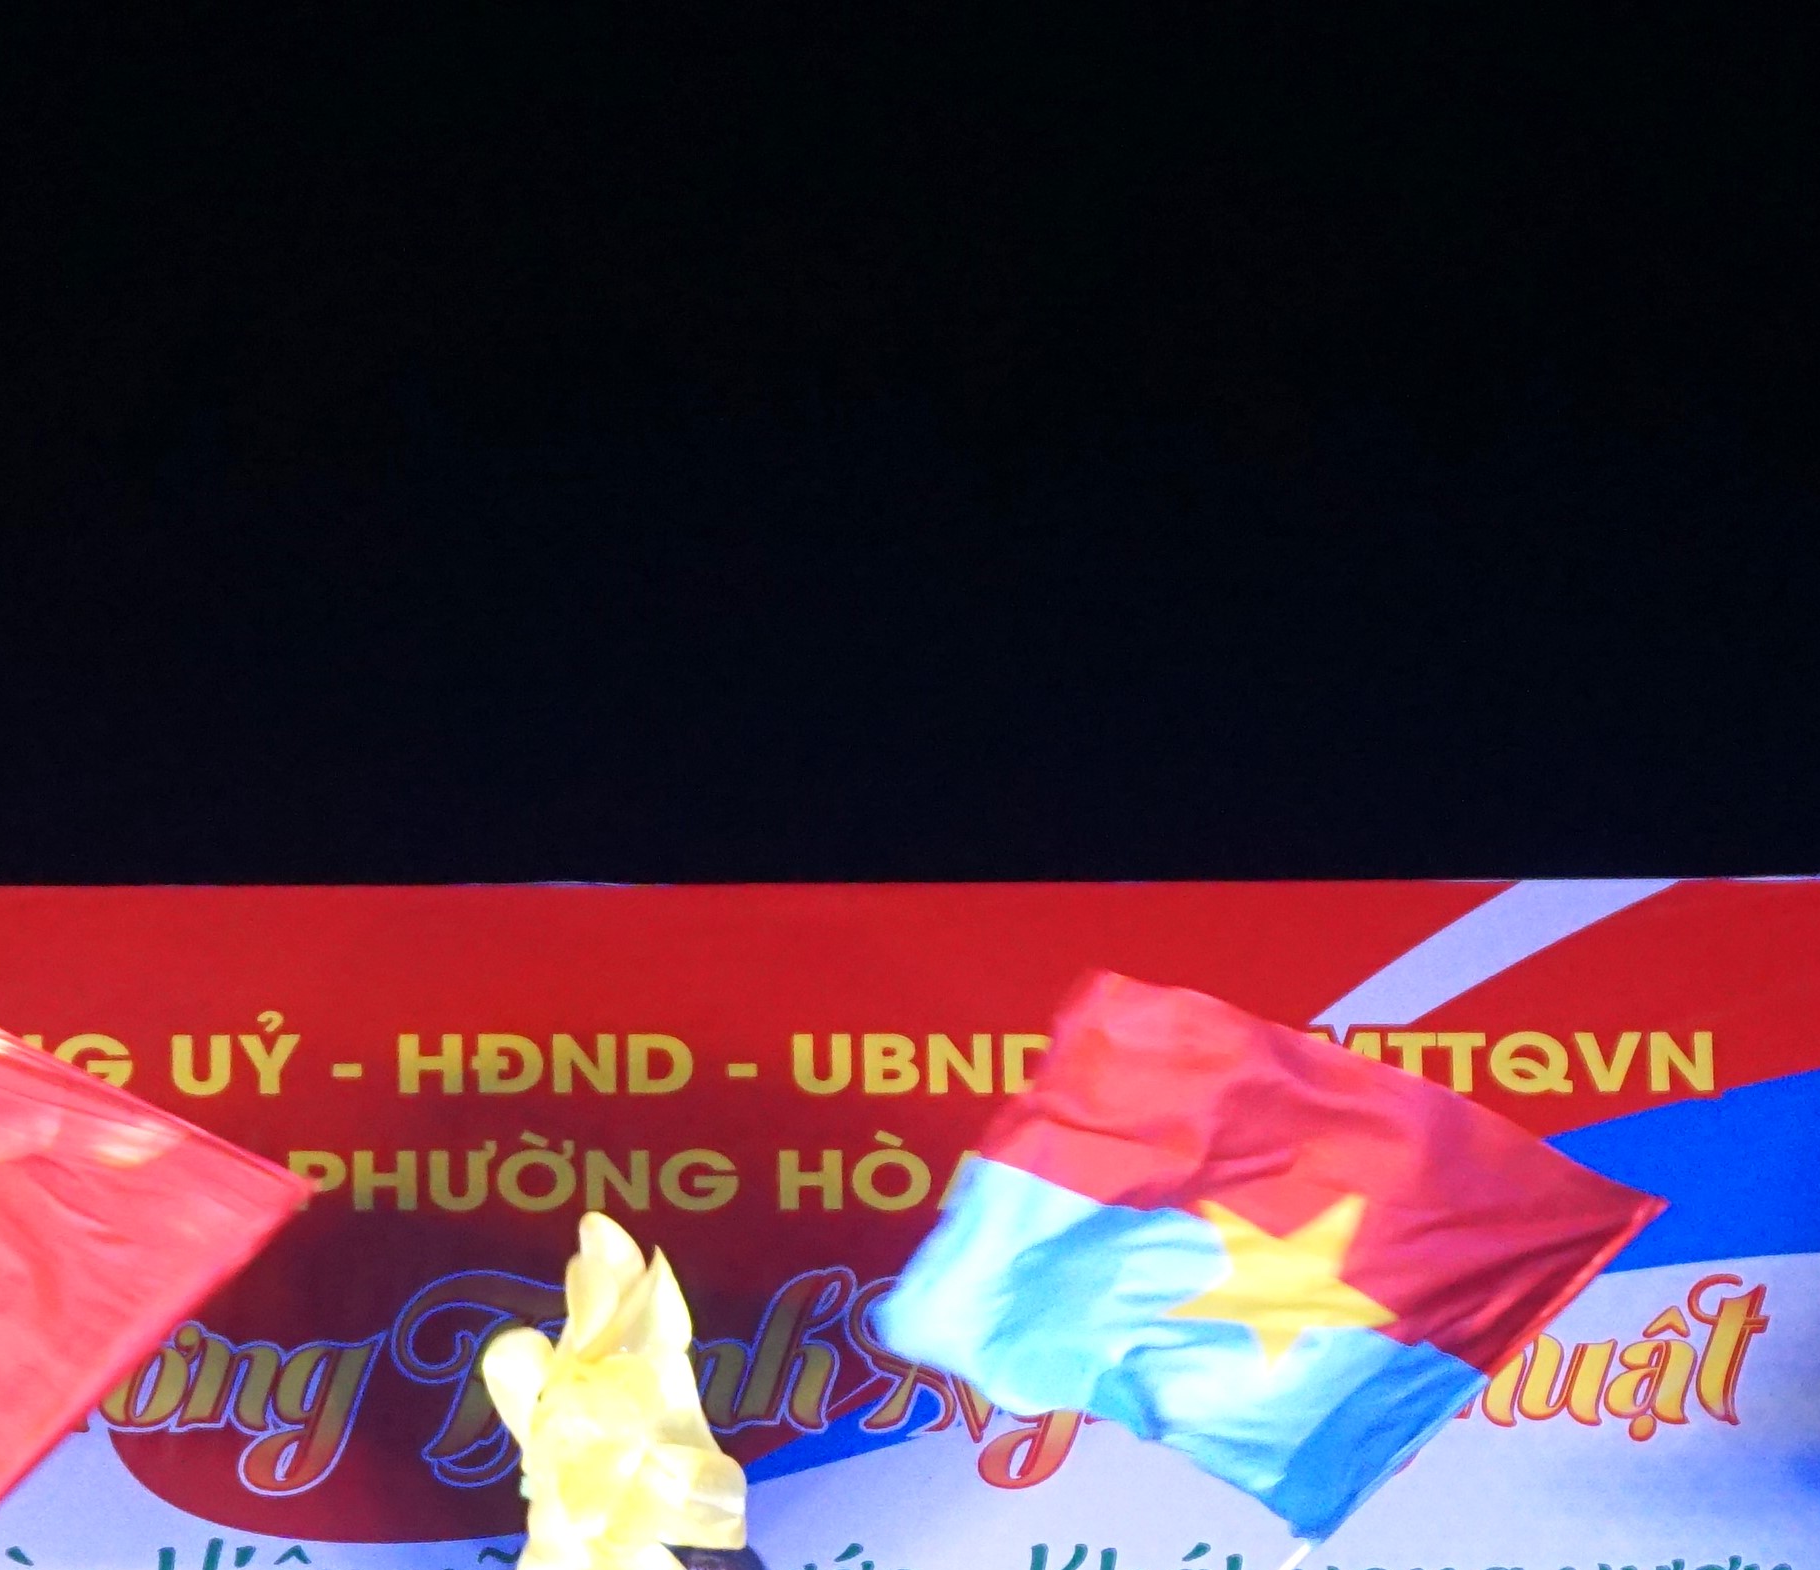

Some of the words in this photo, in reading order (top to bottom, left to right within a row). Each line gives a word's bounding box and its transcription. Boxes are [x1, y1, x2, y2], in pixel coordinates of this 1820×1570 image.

[171, 1010, 300, 1096] UỶ
[397, 1032, 693, 1096] HĐND
[287, 1131, 738, 1213] PHƯỜNG
[778, 1129, 981, 1212] HÒ
